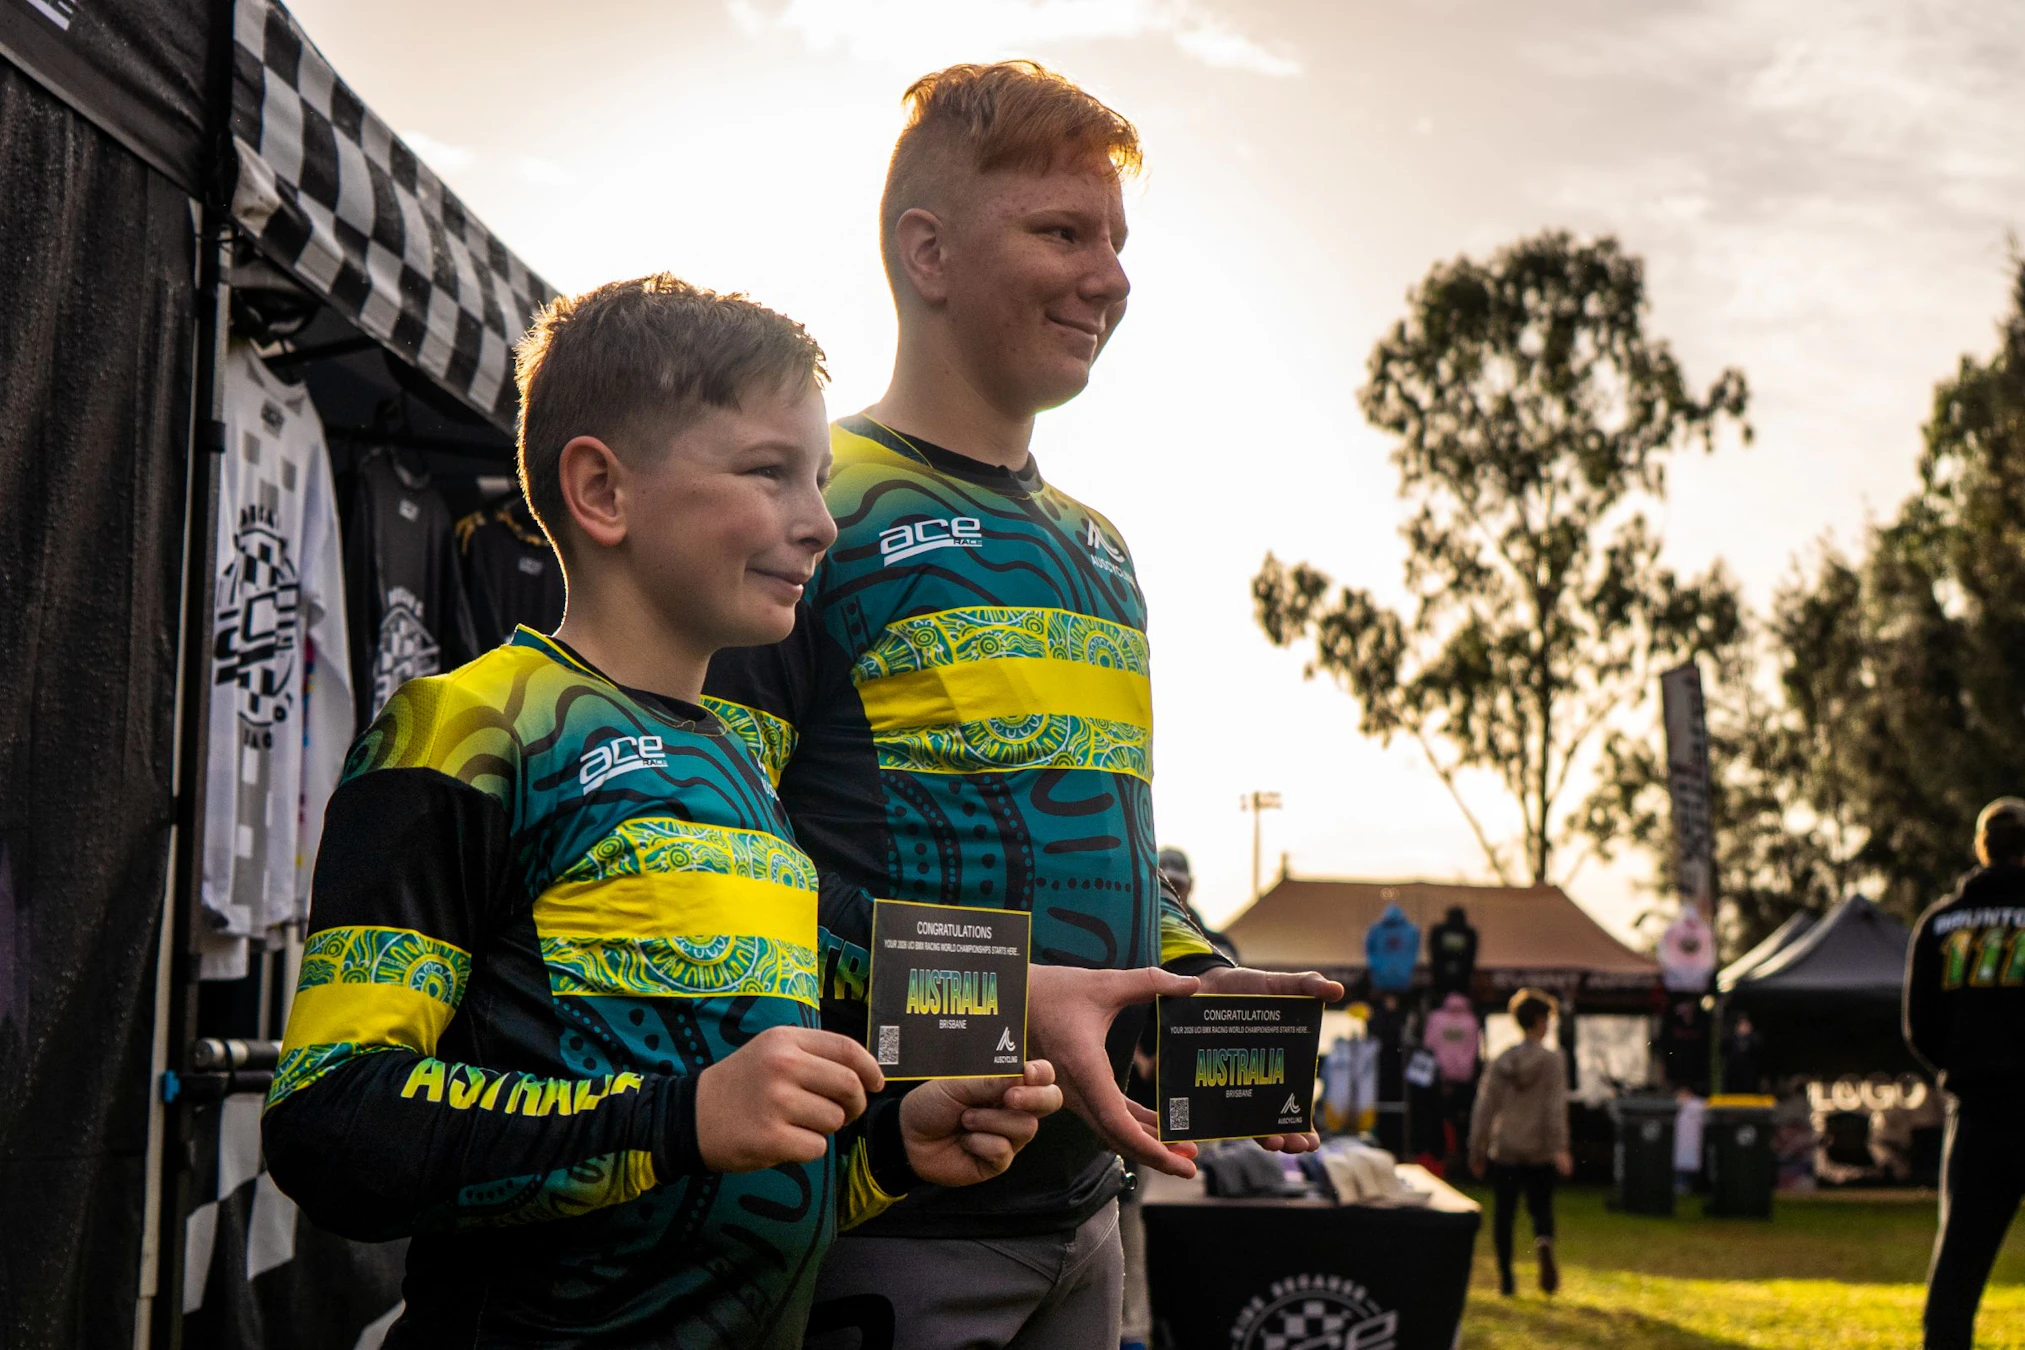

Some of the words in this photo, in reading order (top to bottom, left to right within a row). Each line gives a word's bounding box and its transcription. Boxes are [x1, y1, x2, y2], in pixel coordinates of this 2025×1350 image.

[917, 921, 992, 939] CONGRATULATIONS
[884, 939, 897, 949] YOUR
[907, 940, 915, 950] UCI
[924, 942, 940, 952] RACING
[940, 943, 956, 953] WORLD
[956, 944, 991, 954] CHAMPIONSHIPS
[991, 946, 1007, 955] STARTS
[906, 968, 998, 1015] AUSTRALIA
[1203, 1009, 1281, 1021] CONGRATULATIONS
[939, 1019, 967, 1030] BRISBANE
[1170, 1026, 1184, 1034] YOUR
[1194, 1026, 1202, 1034] UCI
[1212, 1026, 1228, 1034] RACING
[1228, 1026, 1244, 1034] WORLD
[1244, 1026, 1279, 1034] CHAMPIONSHIPS
[1279, 1026, 1295, 1034] STARTS
[993, 1055, 1018, 1064] AUSCYCLING
[1194, 1048, 1284, 1087] AUSTRALIA
[1225, 1089, 1253, 1099] BRISBANE
[1278, 1116, 1303, 1125] AUSCYCLING
